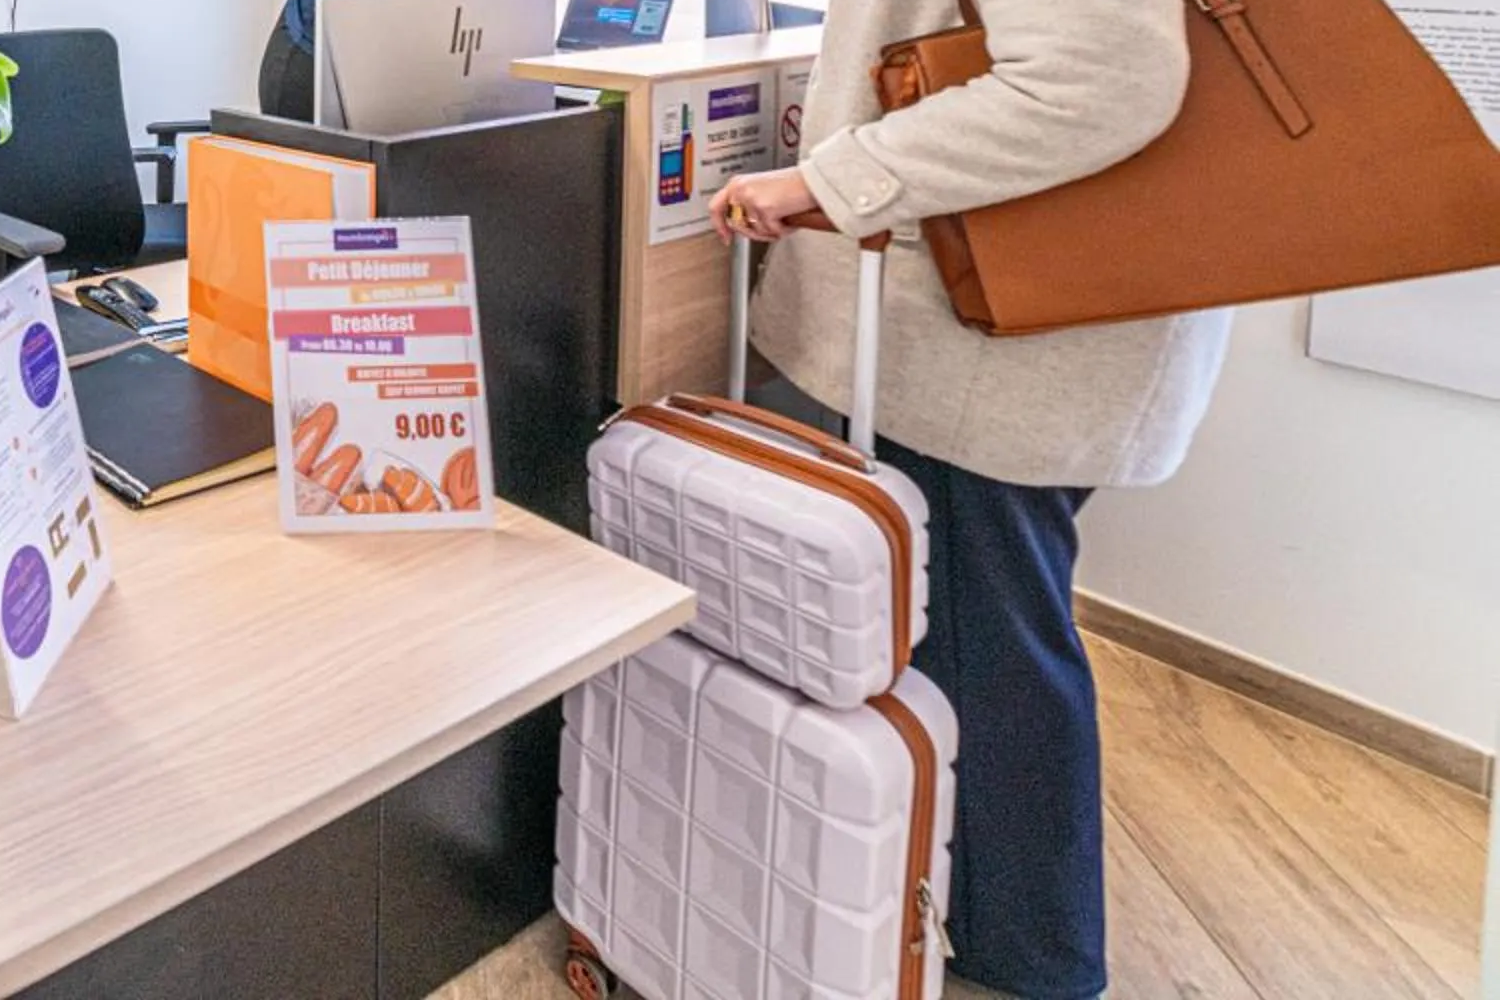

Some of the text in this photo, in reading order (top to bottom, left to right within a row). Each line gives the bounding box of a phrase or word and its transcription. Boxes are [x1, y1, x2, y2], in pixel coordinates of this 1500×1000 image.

[450, 5, 483, 77] hp
[307, 259, 430, 281] Petit Déjeuner
[330, 313, 416, 334] Breakfast
[395, 411, 465, 440] 9,00 €
